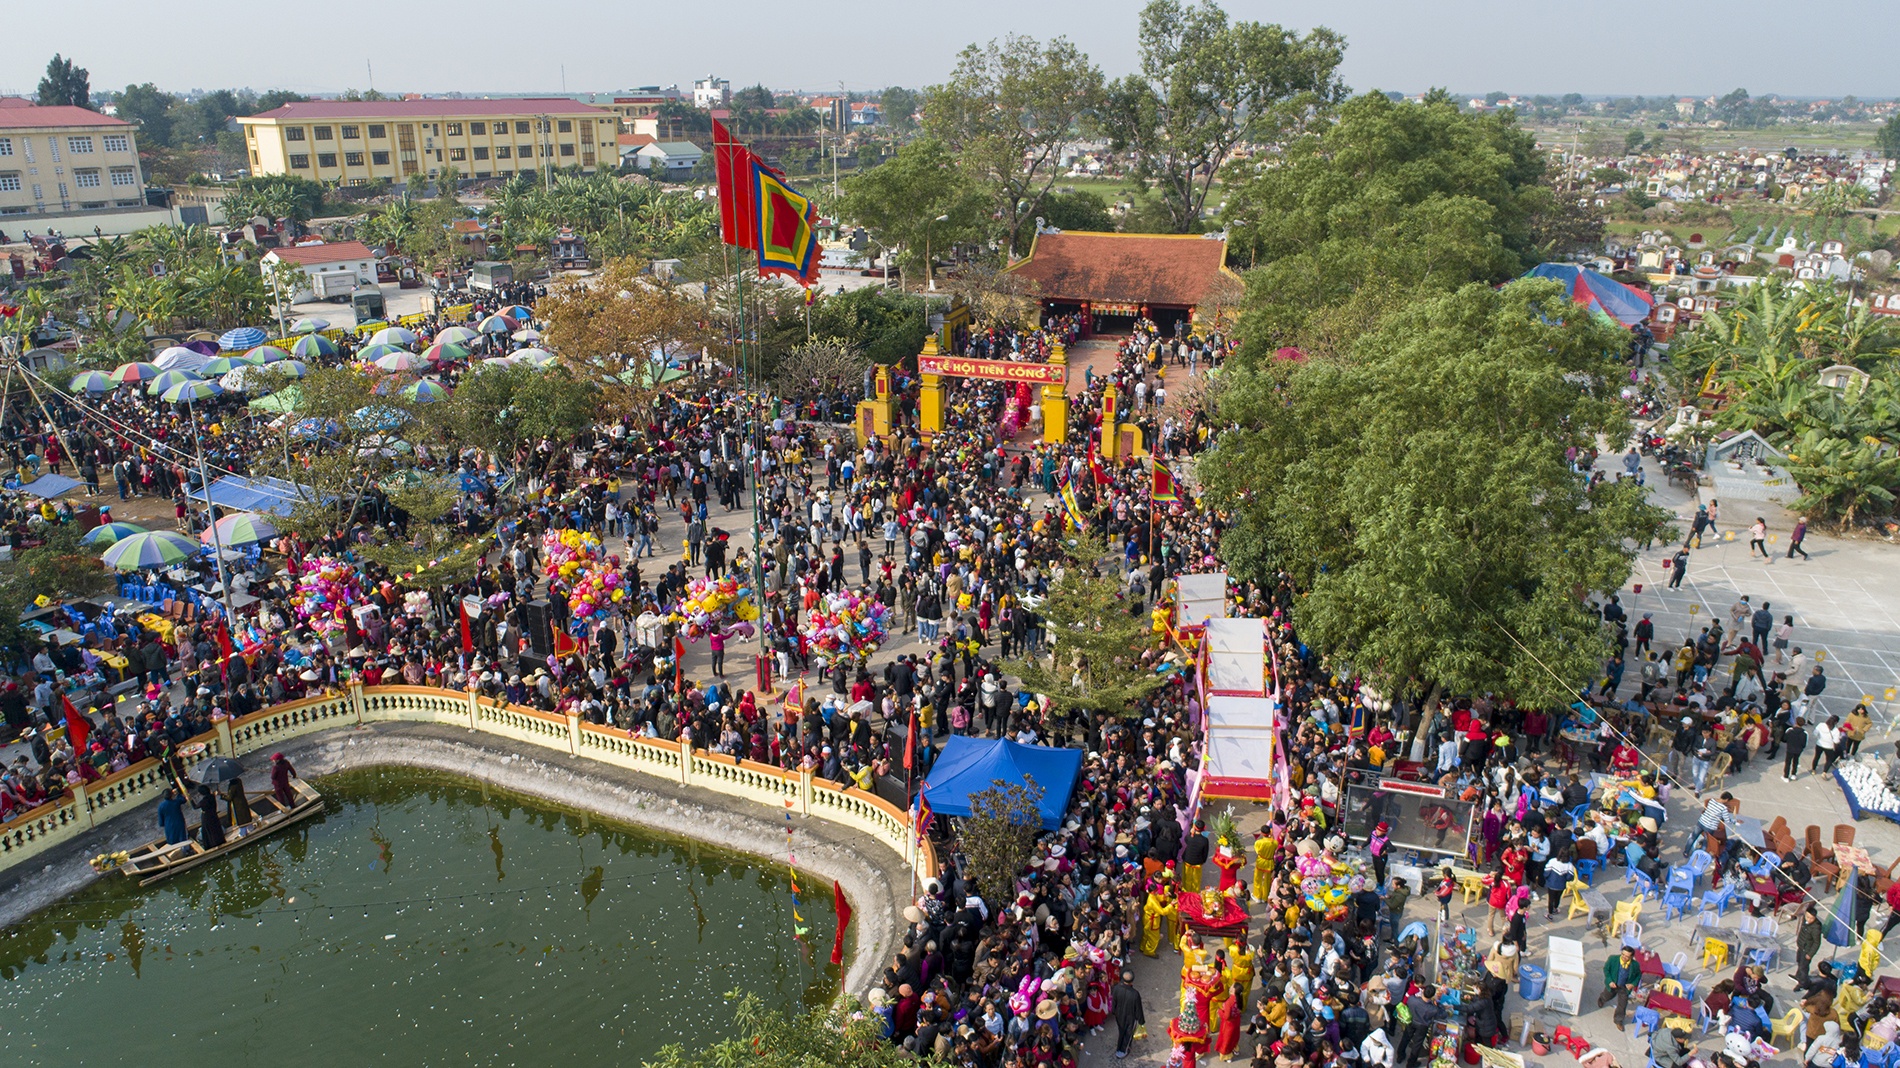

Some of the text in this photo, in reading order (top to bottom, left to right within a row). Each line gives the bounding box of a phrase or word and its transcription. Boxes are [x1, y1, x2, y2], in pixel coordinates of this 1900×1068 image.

[953, 362, 975, 374] HỘI
[978, 364, 1004, 375] TIÊN
[1008, 366, 1046, 378] CÔNG
